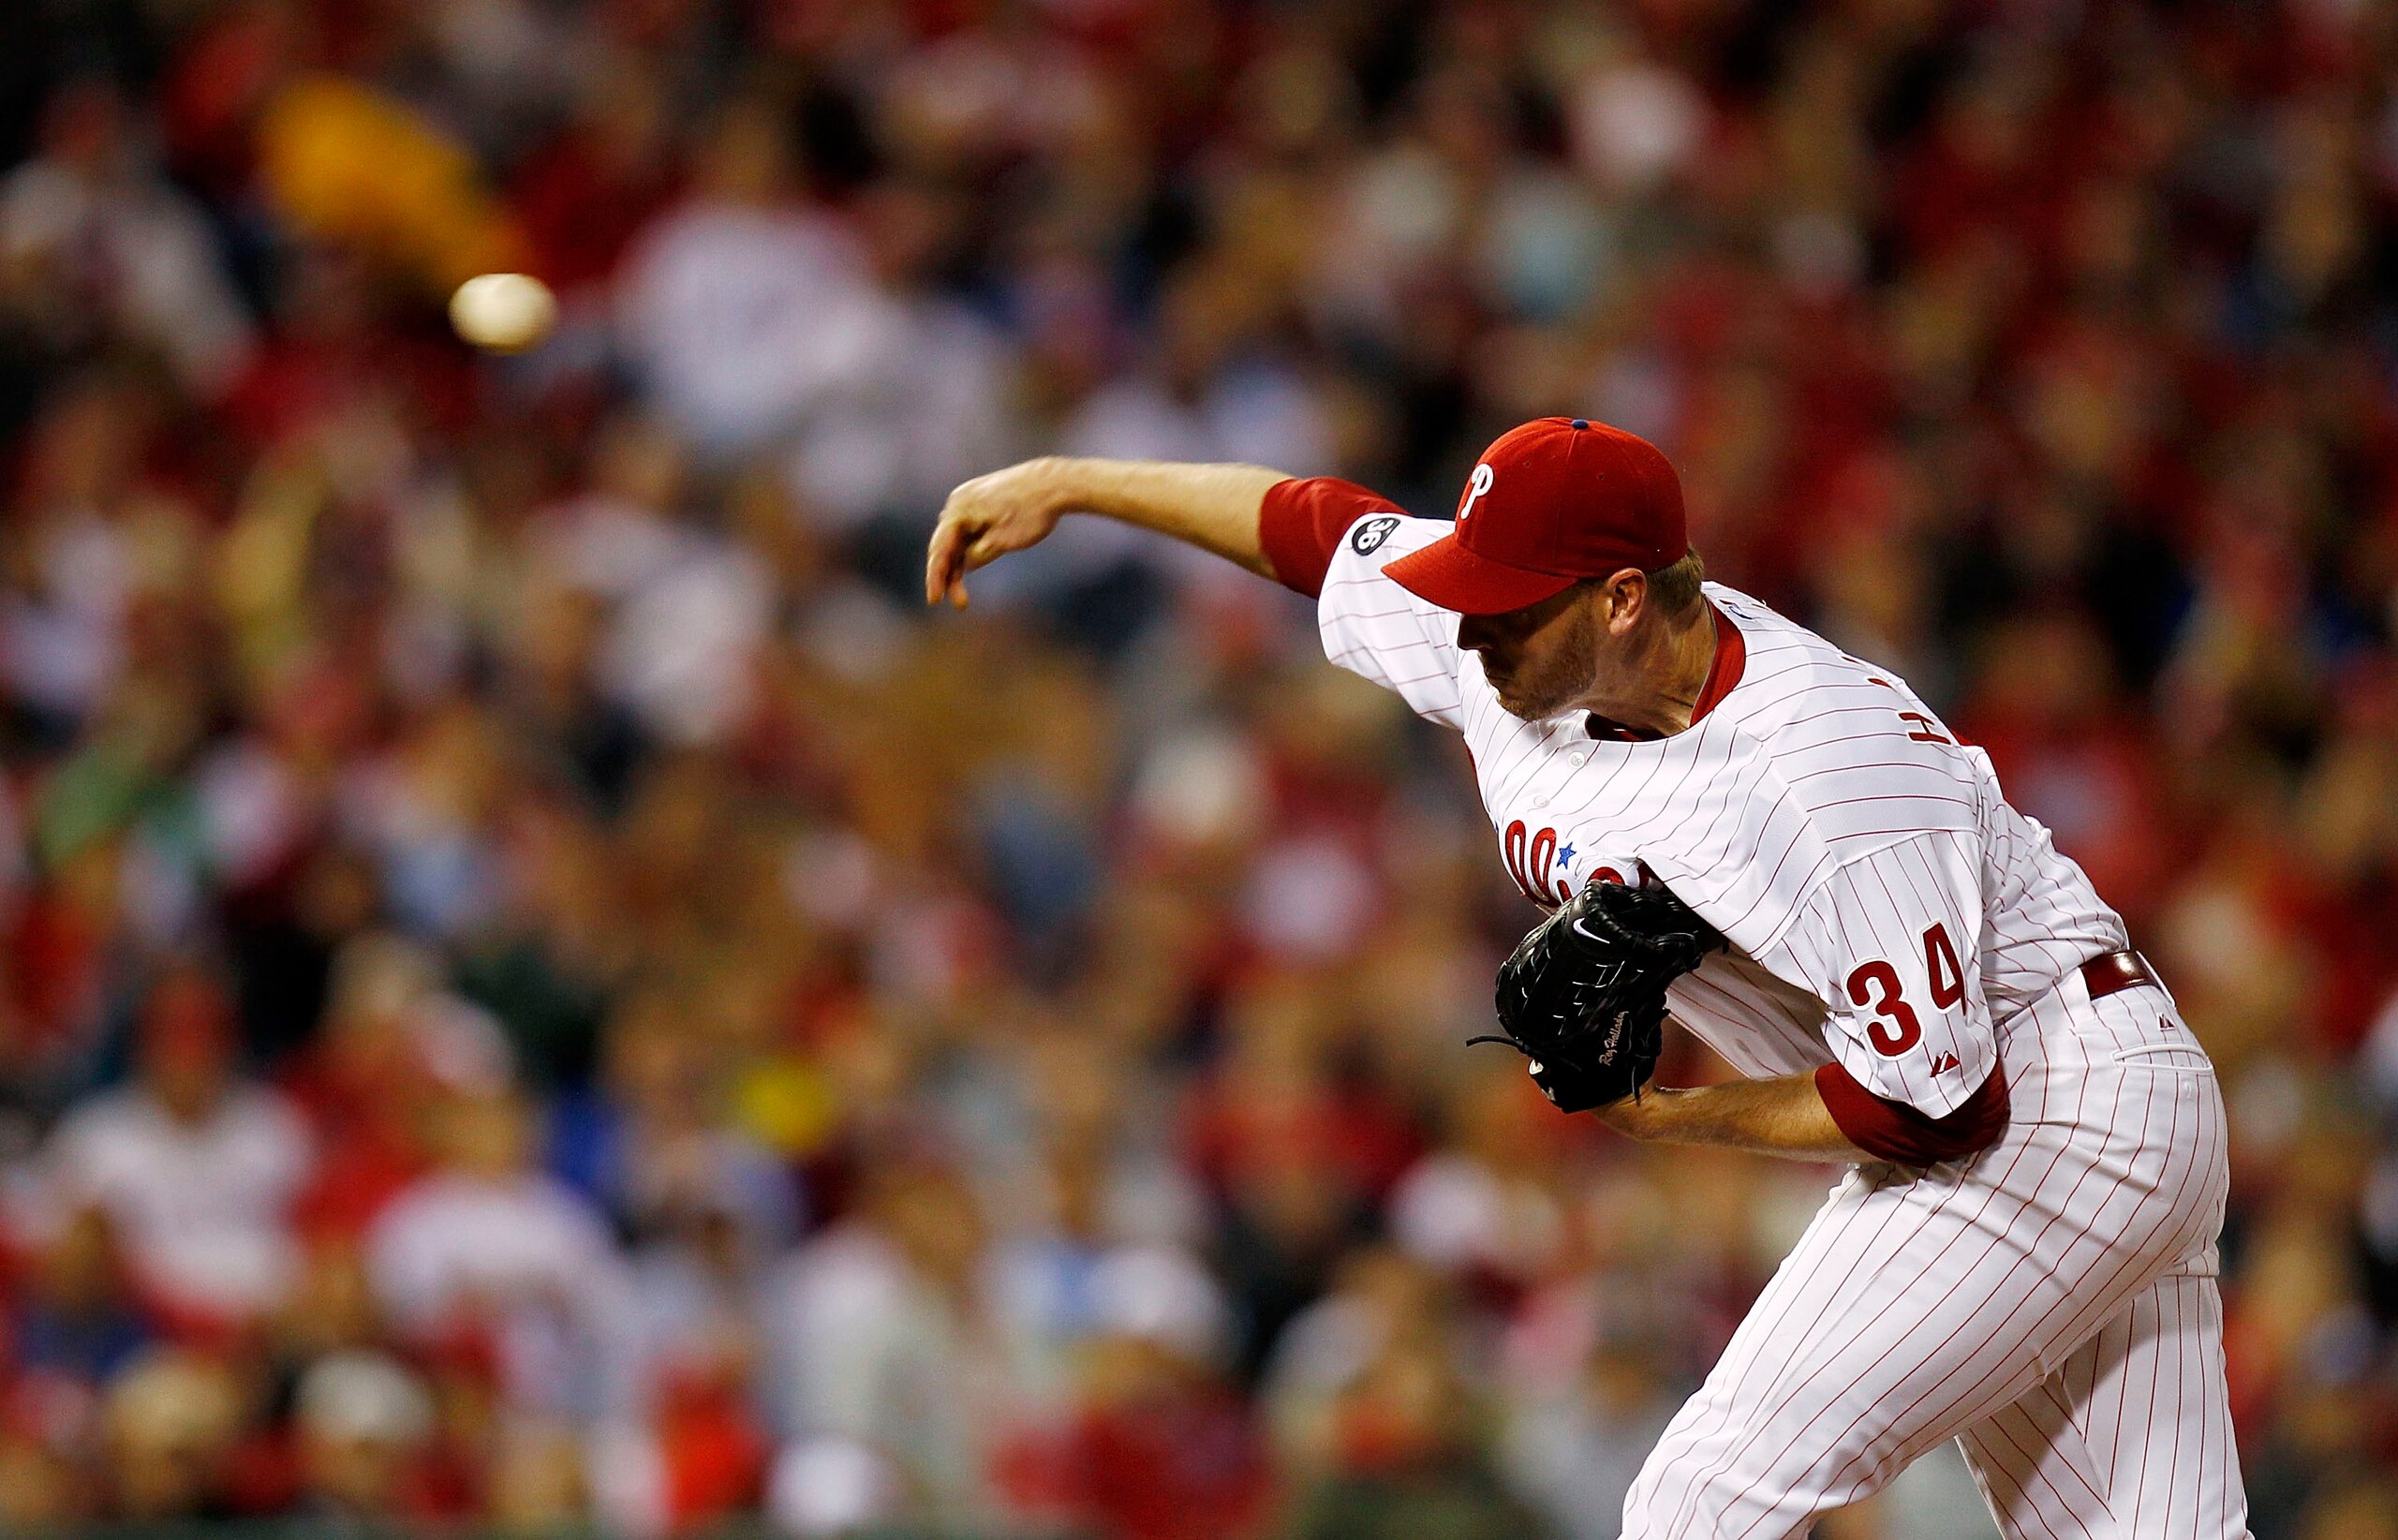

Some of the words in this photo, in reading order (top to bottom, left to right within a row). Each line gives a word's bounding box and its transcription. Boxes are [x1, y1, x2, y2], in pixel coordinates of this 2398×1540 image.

[1460, 463, 1494, 520] P
[1357, 519, 1395, 551] 36
[1846, 912, 1967, 1058] 34
[1598, 1049, 1618, 1066] Roy
